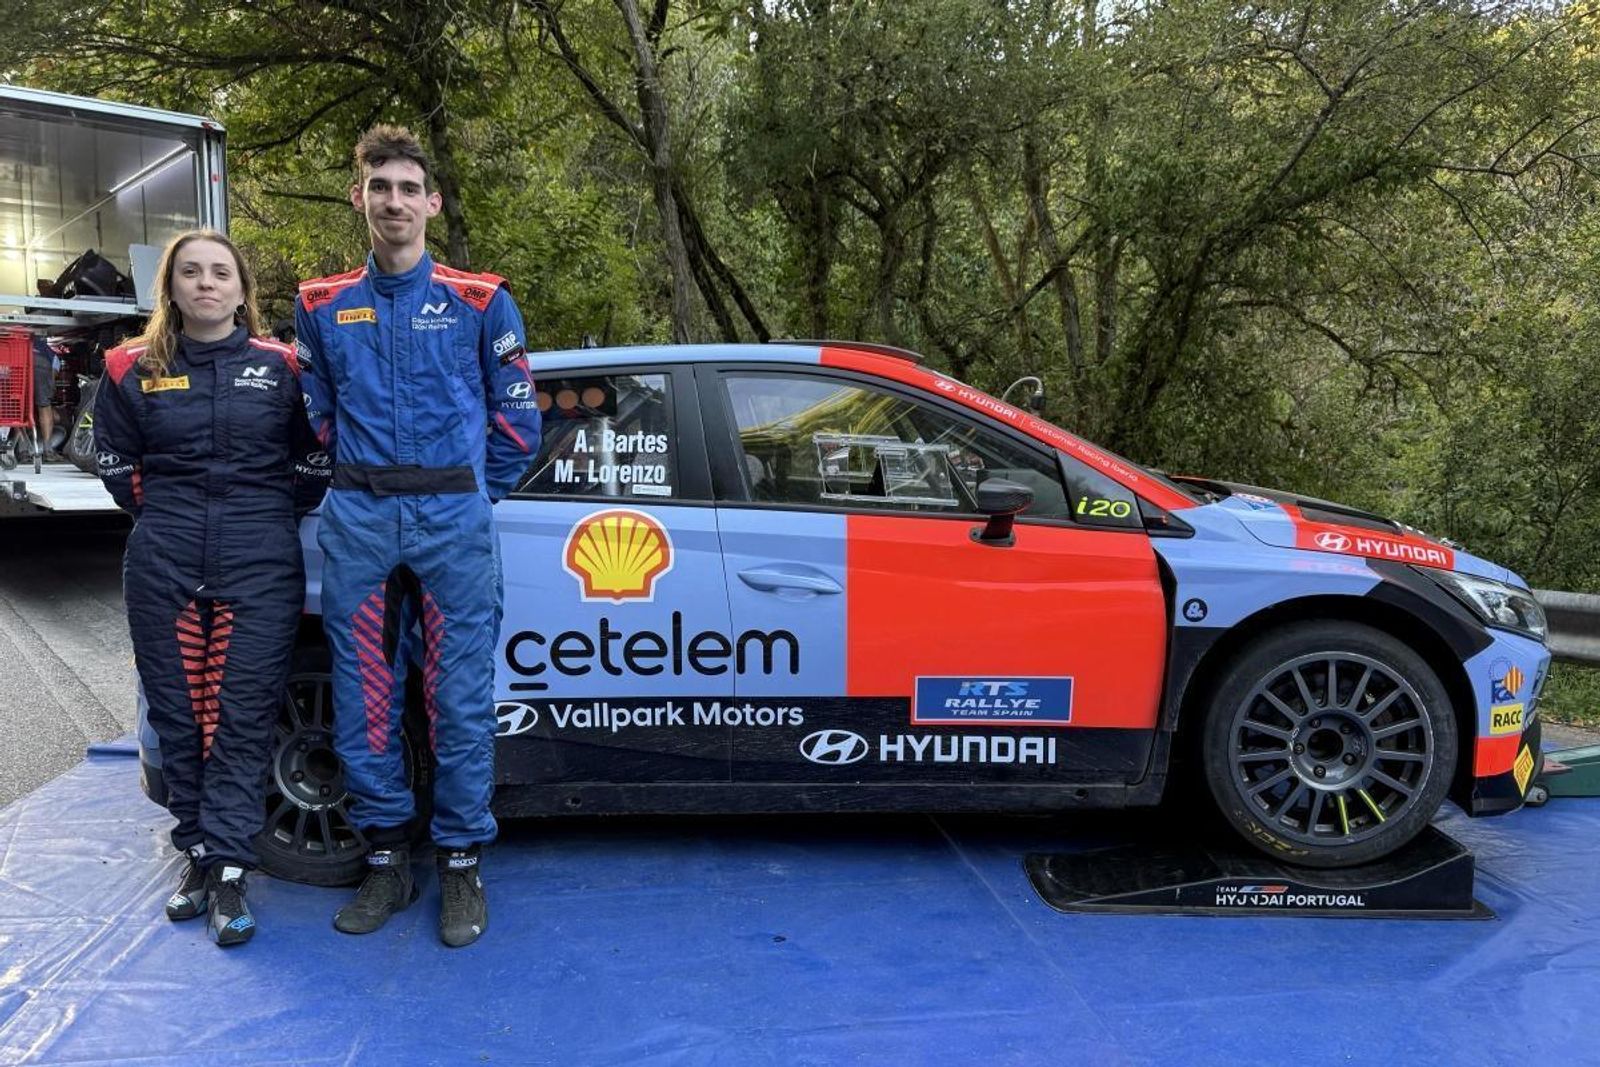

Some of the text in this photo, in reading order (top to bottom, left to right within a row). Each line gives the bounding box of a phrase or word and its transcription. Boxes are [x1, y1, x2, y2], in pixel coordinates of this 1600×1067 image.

[306, 289, 328, 301] OMP
[464, 287, 487, 299] OMP
[493, 333, 516, 354] OMP
[958, 389, 1017, 420] HYUNDAI
[574, 430, 668, 453] A. Bartes
[295, 464, 332, 476] HYUNDAI
[554, 459, 665, 484] M. Lorenzo
[1077, 496, 1131, 518] i20
[1356, 537, 1447, 565] HYUNDAI
[505, 610, 799, 691] cetelem
[959, 681, 1029, 696] RTS
[945, 698, 1041, 709] RALLYE
[550, 702, 804, 732] Vallpark Motors
[1493, 710, 1522, 728] RACC
[880, 734, 1056, 764] HYUNDAI
[1286, 895, 1365, 907] PORTUGAL
